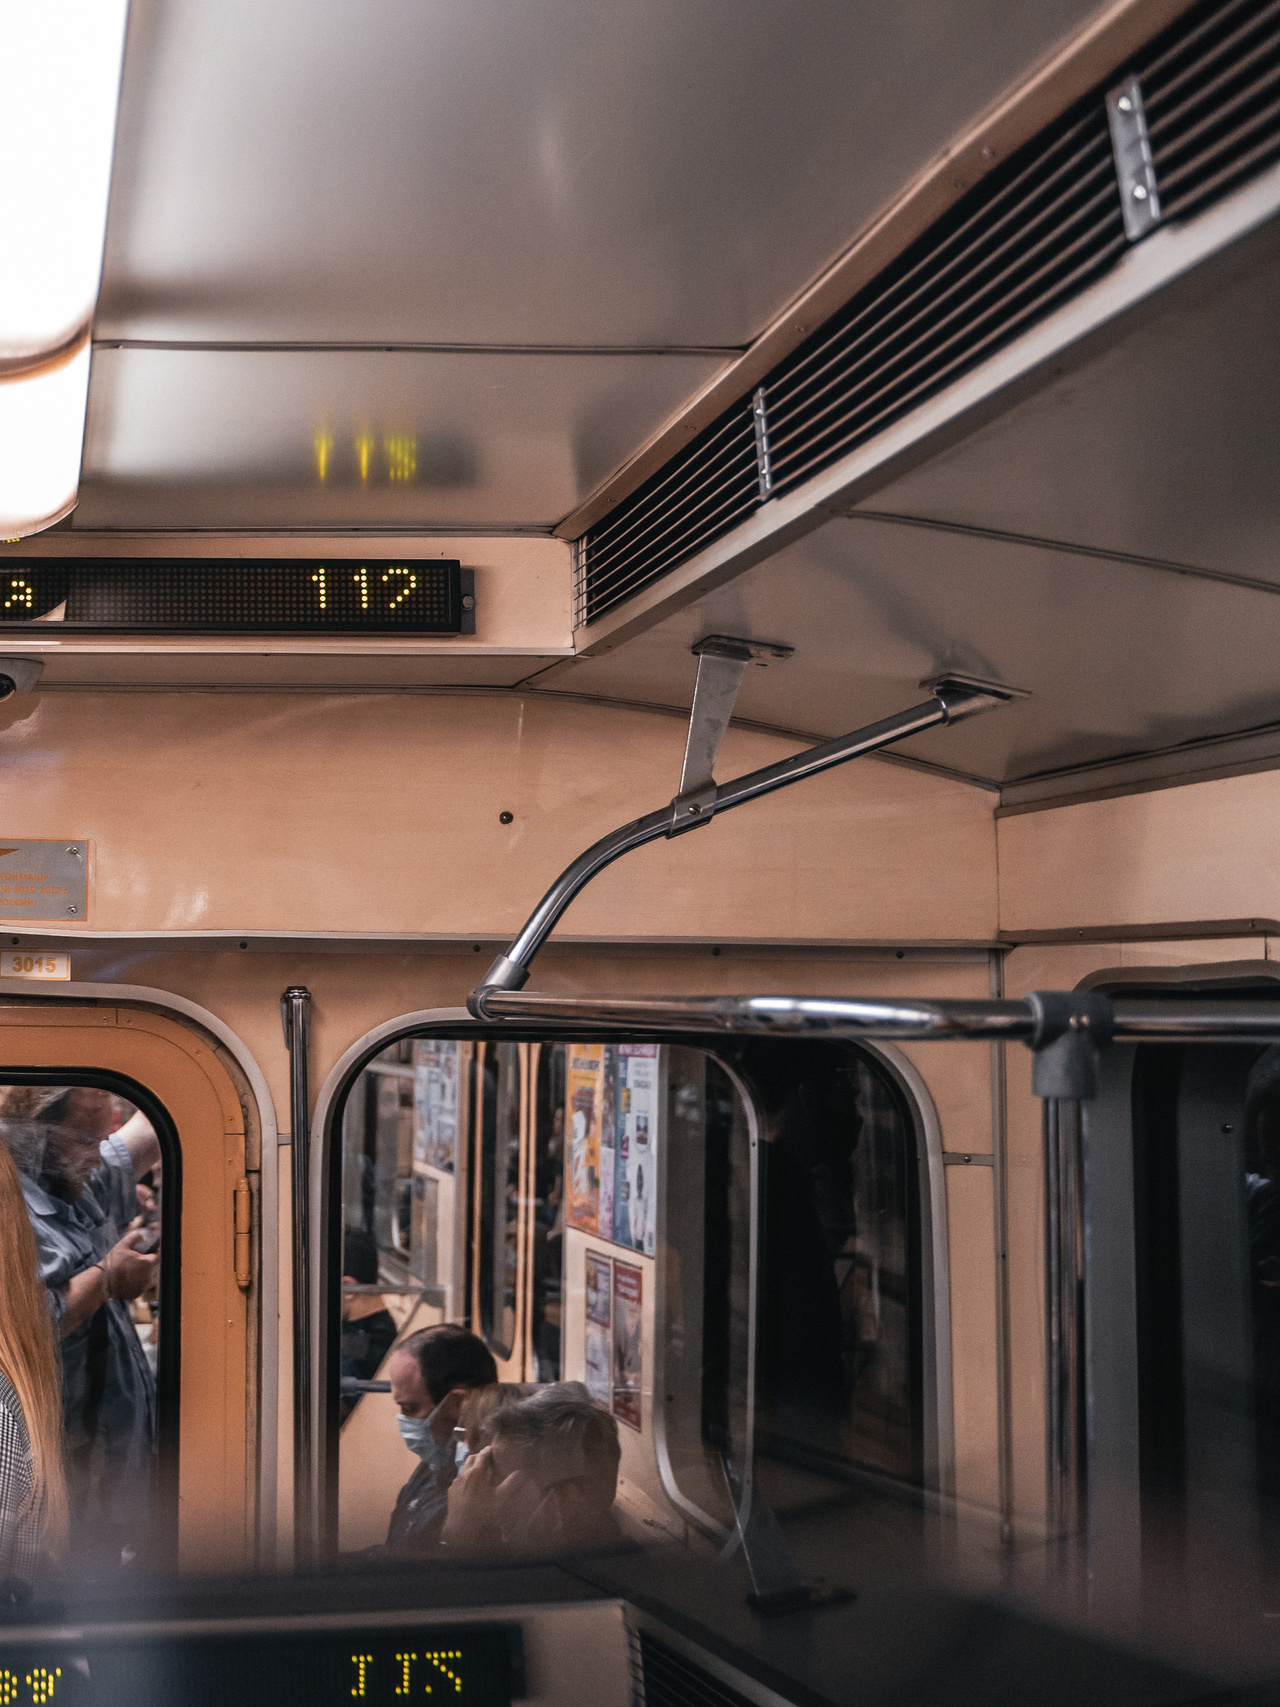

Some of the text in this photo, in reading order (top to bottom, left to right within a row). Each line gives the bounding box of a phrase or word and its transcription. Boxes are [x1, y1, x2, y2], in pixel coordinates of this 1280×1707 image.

[14, 885, 35, 894] 3015
[40, 886, 62, 895] 2012
[12, 956, 57, 973] 3015
